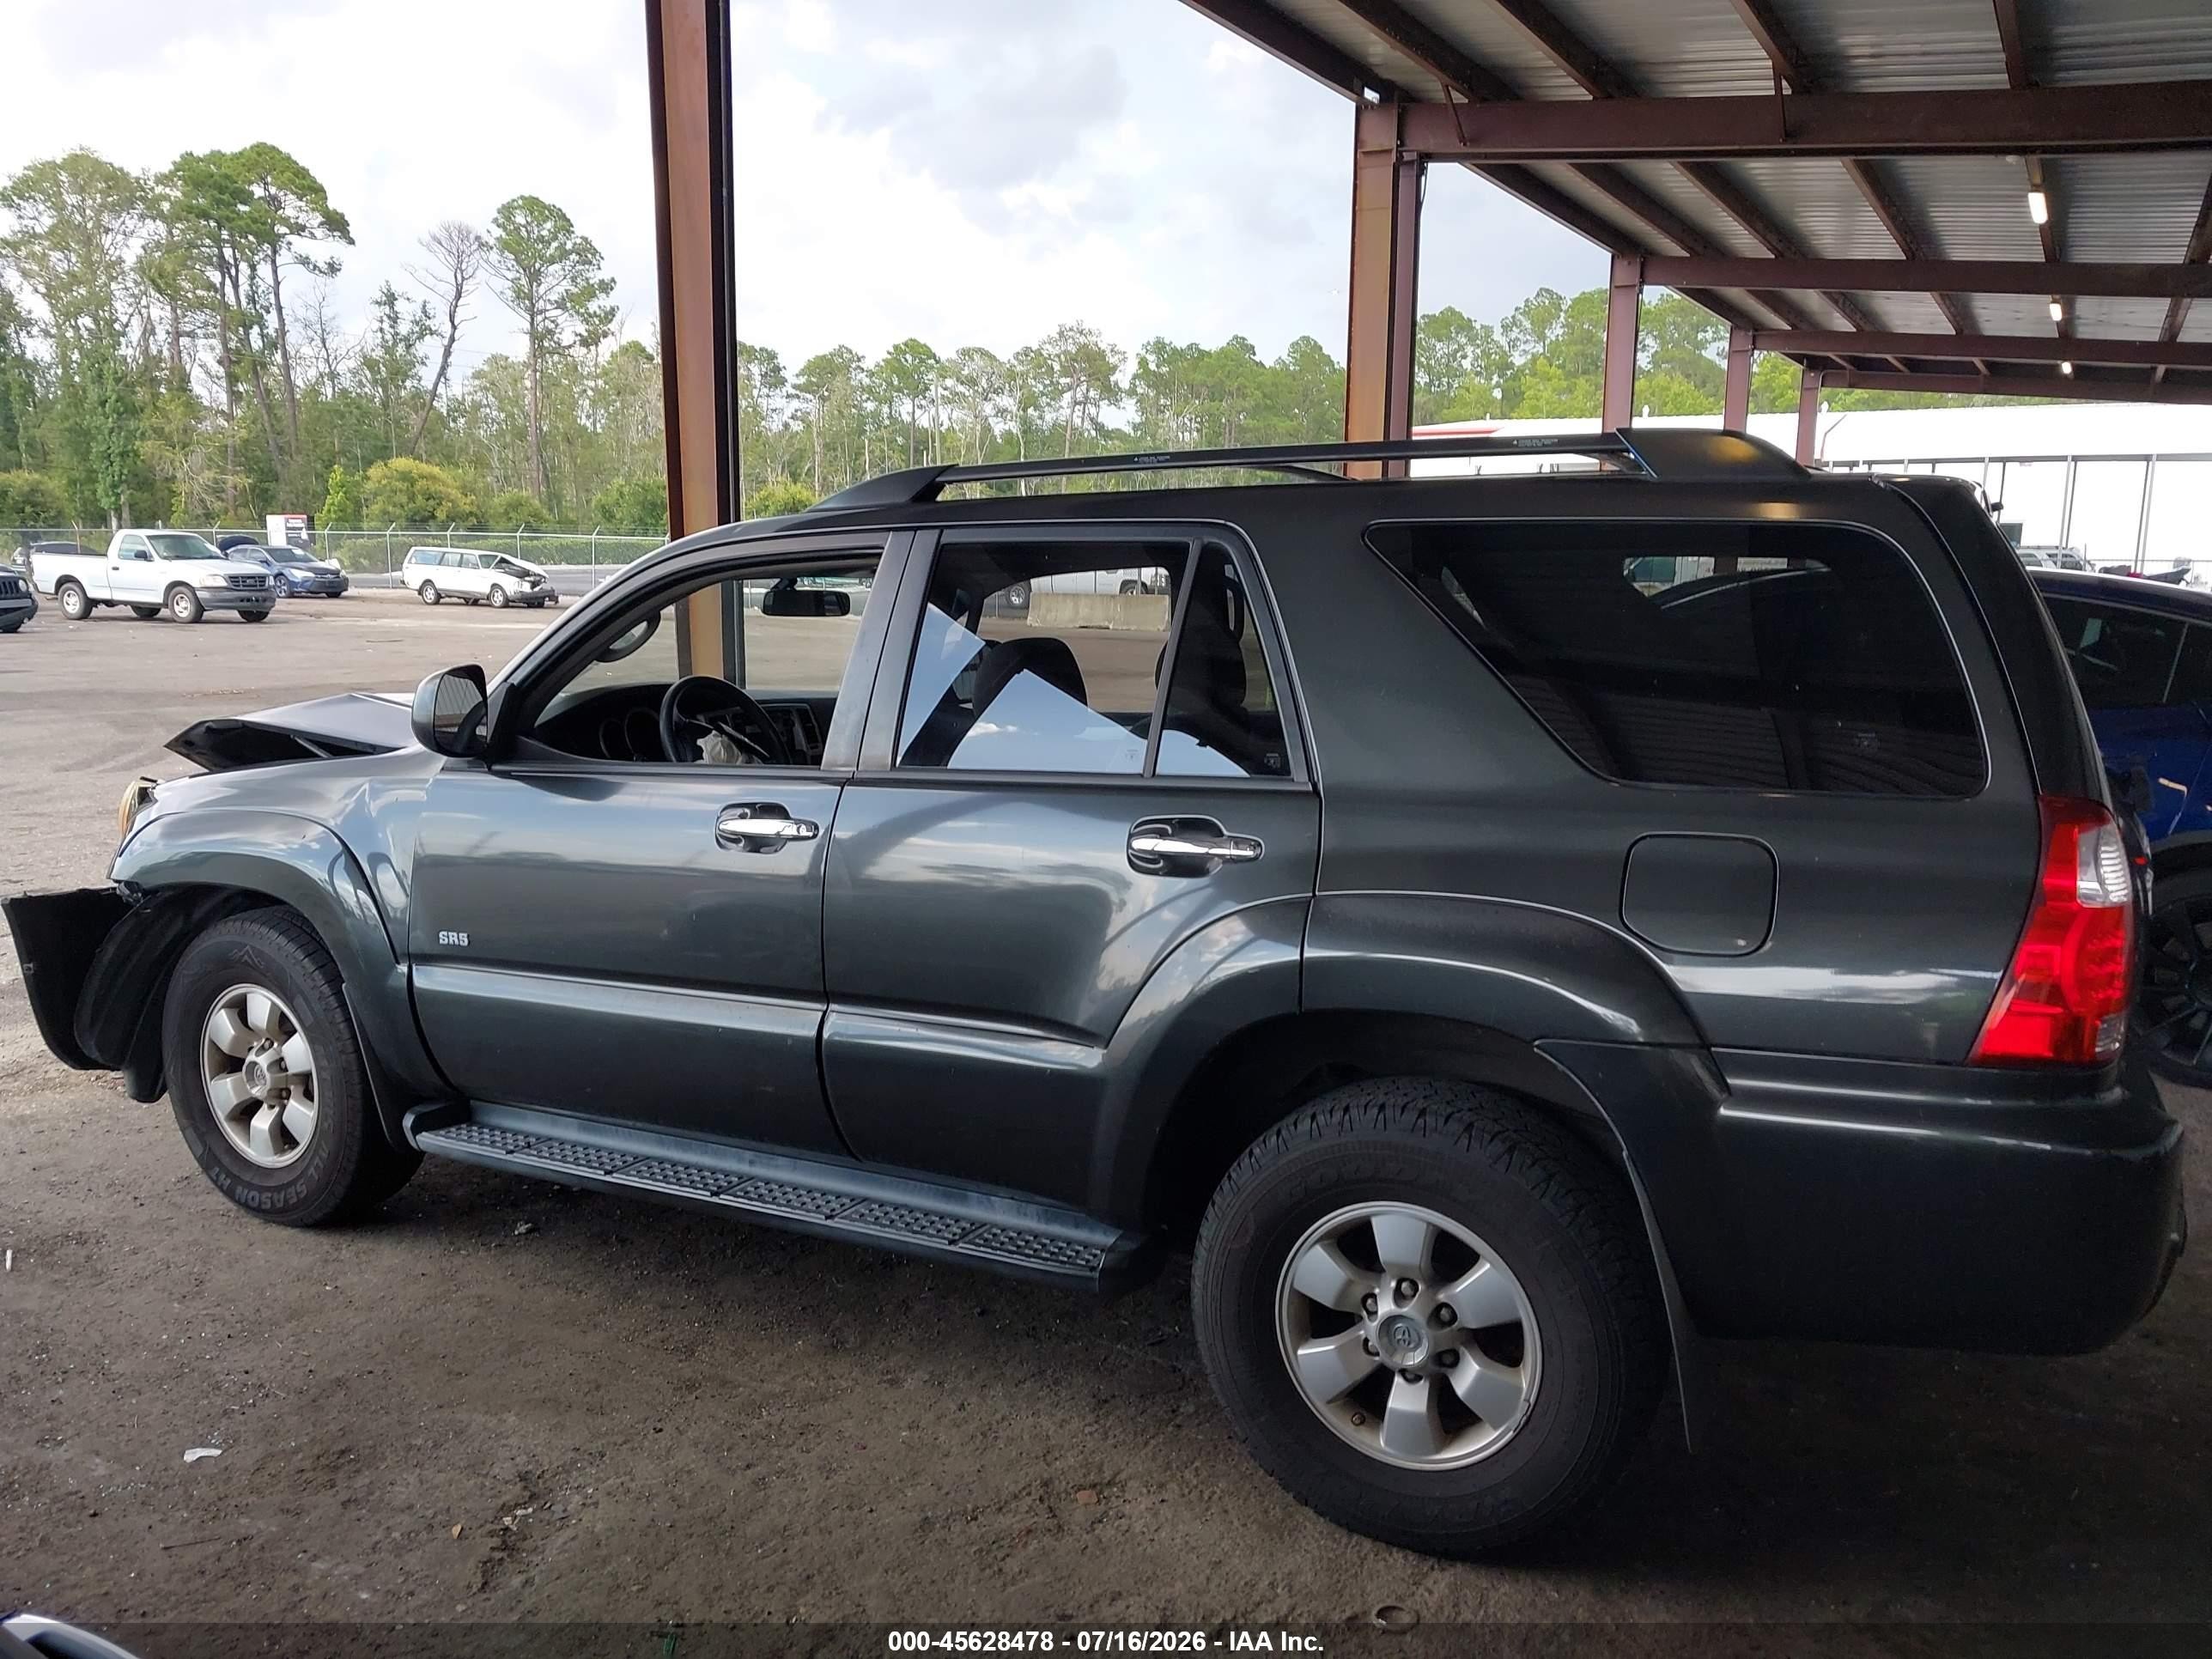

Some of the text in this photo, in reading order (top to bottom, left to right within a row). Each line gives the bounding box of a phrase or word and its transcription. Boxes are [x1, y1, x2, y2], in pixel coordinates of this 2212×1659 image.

[439, 931, 469, 946] SR5
[211, 1167, 233, 1191] HT
[234, 1182, 307, 1210] SEASON
